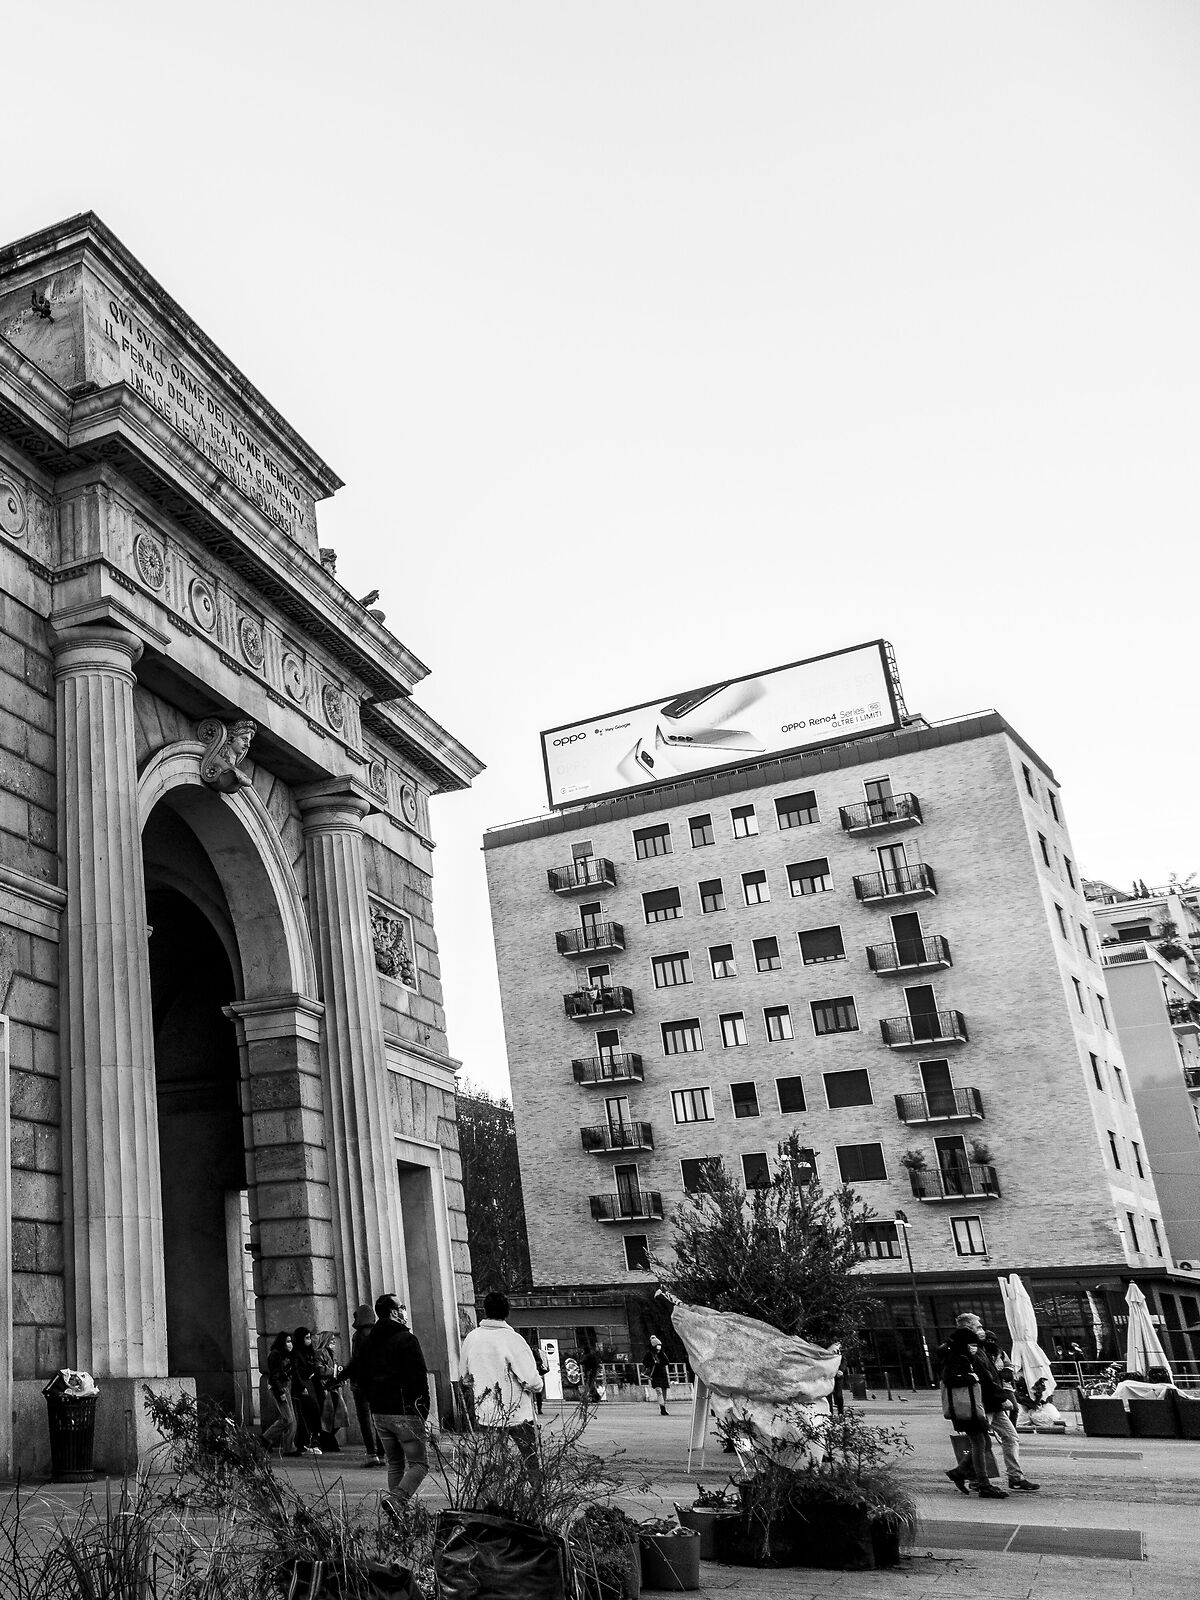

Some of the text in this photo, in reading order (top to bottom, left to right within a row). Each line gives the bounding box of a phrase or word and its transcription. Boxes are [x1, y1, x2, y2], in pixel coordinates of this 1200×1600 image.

[104, 318, 304, 525] IL FERRO DELLA ITALICA GIOVENTV
[109, 301, 301, 500] QVI SVLL ORME DEL NOME NEMICO
[130, 369, 171, 420] INCISE
[175, 411, 190, 438] LE
[193, 429, 247, 493] VITTORIE
[781, 721, 806, 733] OPPO
[809, 713, 836, 726] Reno4
[840, 707, 865, 719] Series
[832, 717, 854, 728] OLTRE
[861, 711, 882, 722] LIMITI
